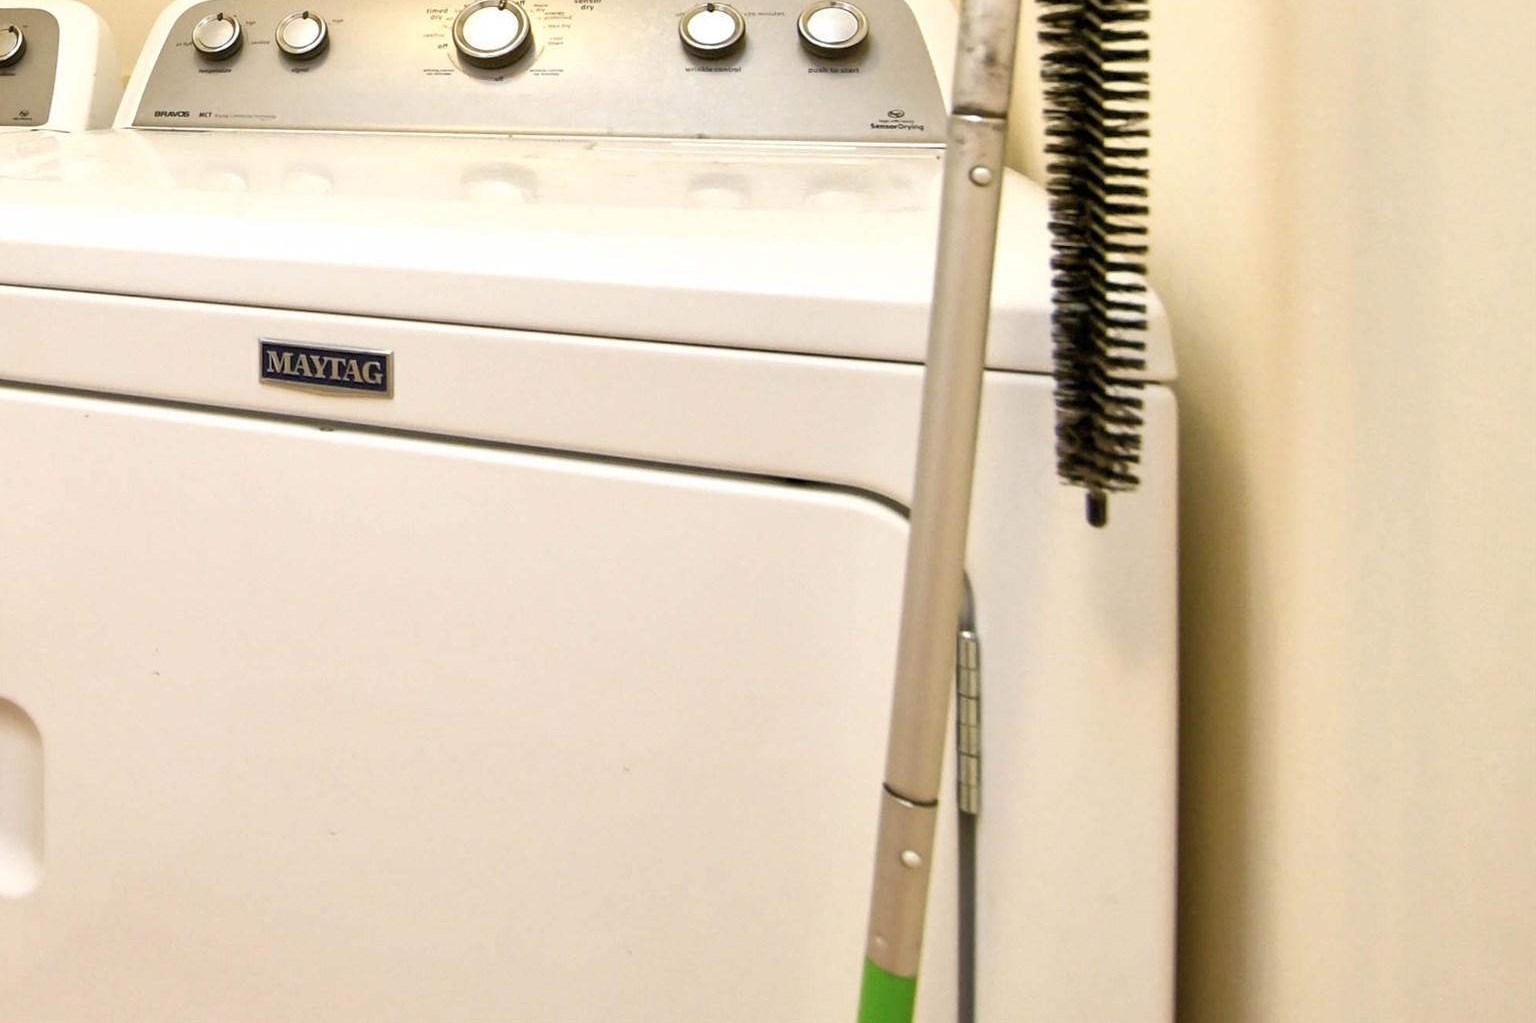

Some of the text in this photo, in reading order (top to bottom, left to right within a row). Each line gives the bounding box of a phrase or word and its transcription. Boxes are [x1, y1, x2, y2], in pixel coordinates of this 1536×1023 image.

[580, 3, 595, 11] dry
[154, 110, 190, 118] BRAVOS
[870, 122, 925, 131] SensorDrying
[266, 349, 384, 385] MAYTAG
